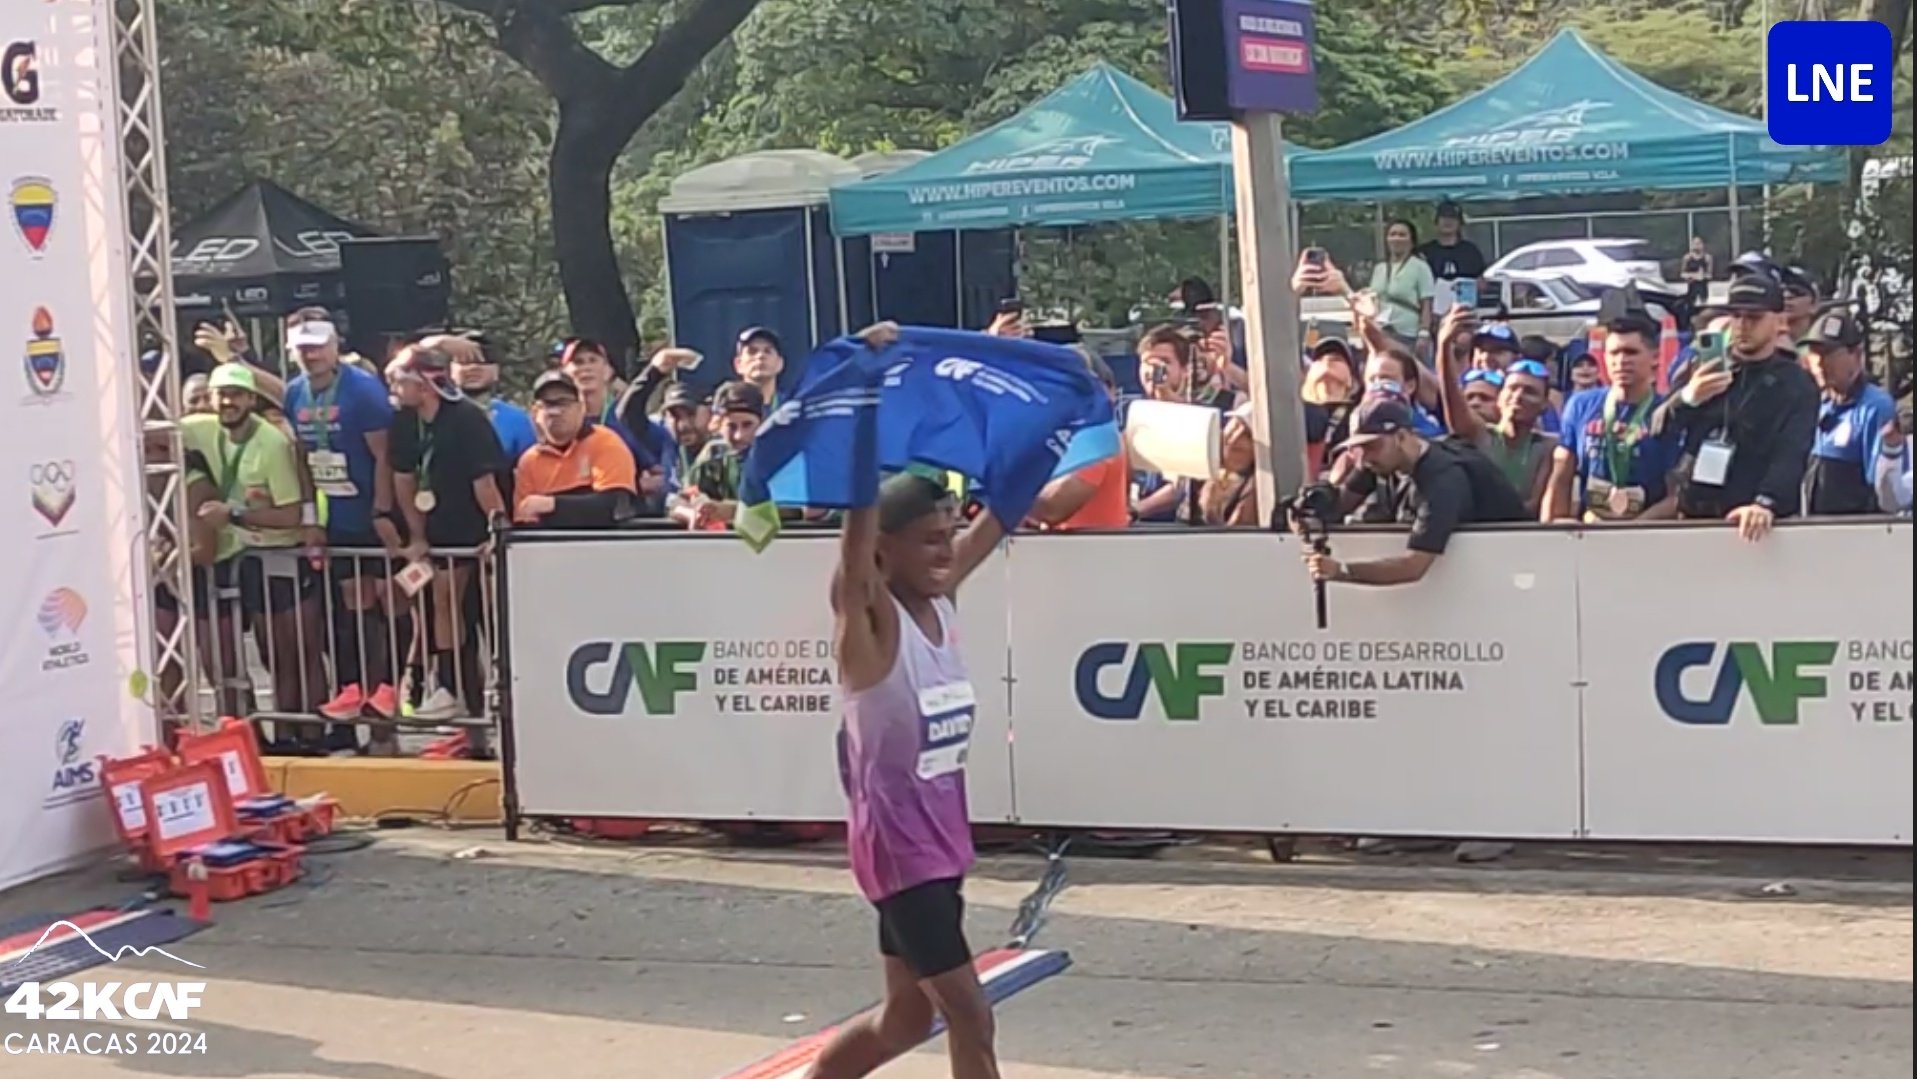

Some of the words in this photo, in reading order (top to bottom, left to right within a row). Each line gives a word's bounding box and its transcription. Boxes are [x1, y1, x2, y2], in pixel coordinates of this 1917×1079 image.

[2, 41, 39, 104] G
[1374, 142, 1628, 169] WWW.HIPEREVENTOS.COM
[908, 174, 1134, 204] WWW.HIPEREVENTOS.COM
[714, 641, 779, 659] BANCO
[786, 641, 810, 659] DE
[1243, 642, 1316, 662] BANCO
[1323, 642, 1352, 662] DE
[1359, 642, 1504, 662] DESARROLLO
[567, 642, 707, 715] CAF
[715, 668, 739, 686] DE
[745, 662, 832, 686] AMÉRICA
[1075, 642, 1235, 720] CAF
[1243, 671, 1271, 690] DE
[1278, 666, 1377, 691] AMÉRICA
[1384, 671, 1464, 691] LATINA
[1655, 642, 1839, 724] CAF
[1849, 671, 1881, 691] DE
[716, 695, 727, 712] Y
[733, 695, 755, 712] EL
[761, 695, 830, 712] CARIBE
[1245, 699, 1258, 718] Y
[1264, 699, 1291, 719] EL
[1296, 699, 1377, 719] CARIBE
[1850, 702, 1866, 722] Y
[1873, 702, 1903, 721] EL
[53, 762, 95, 790] AIMS
